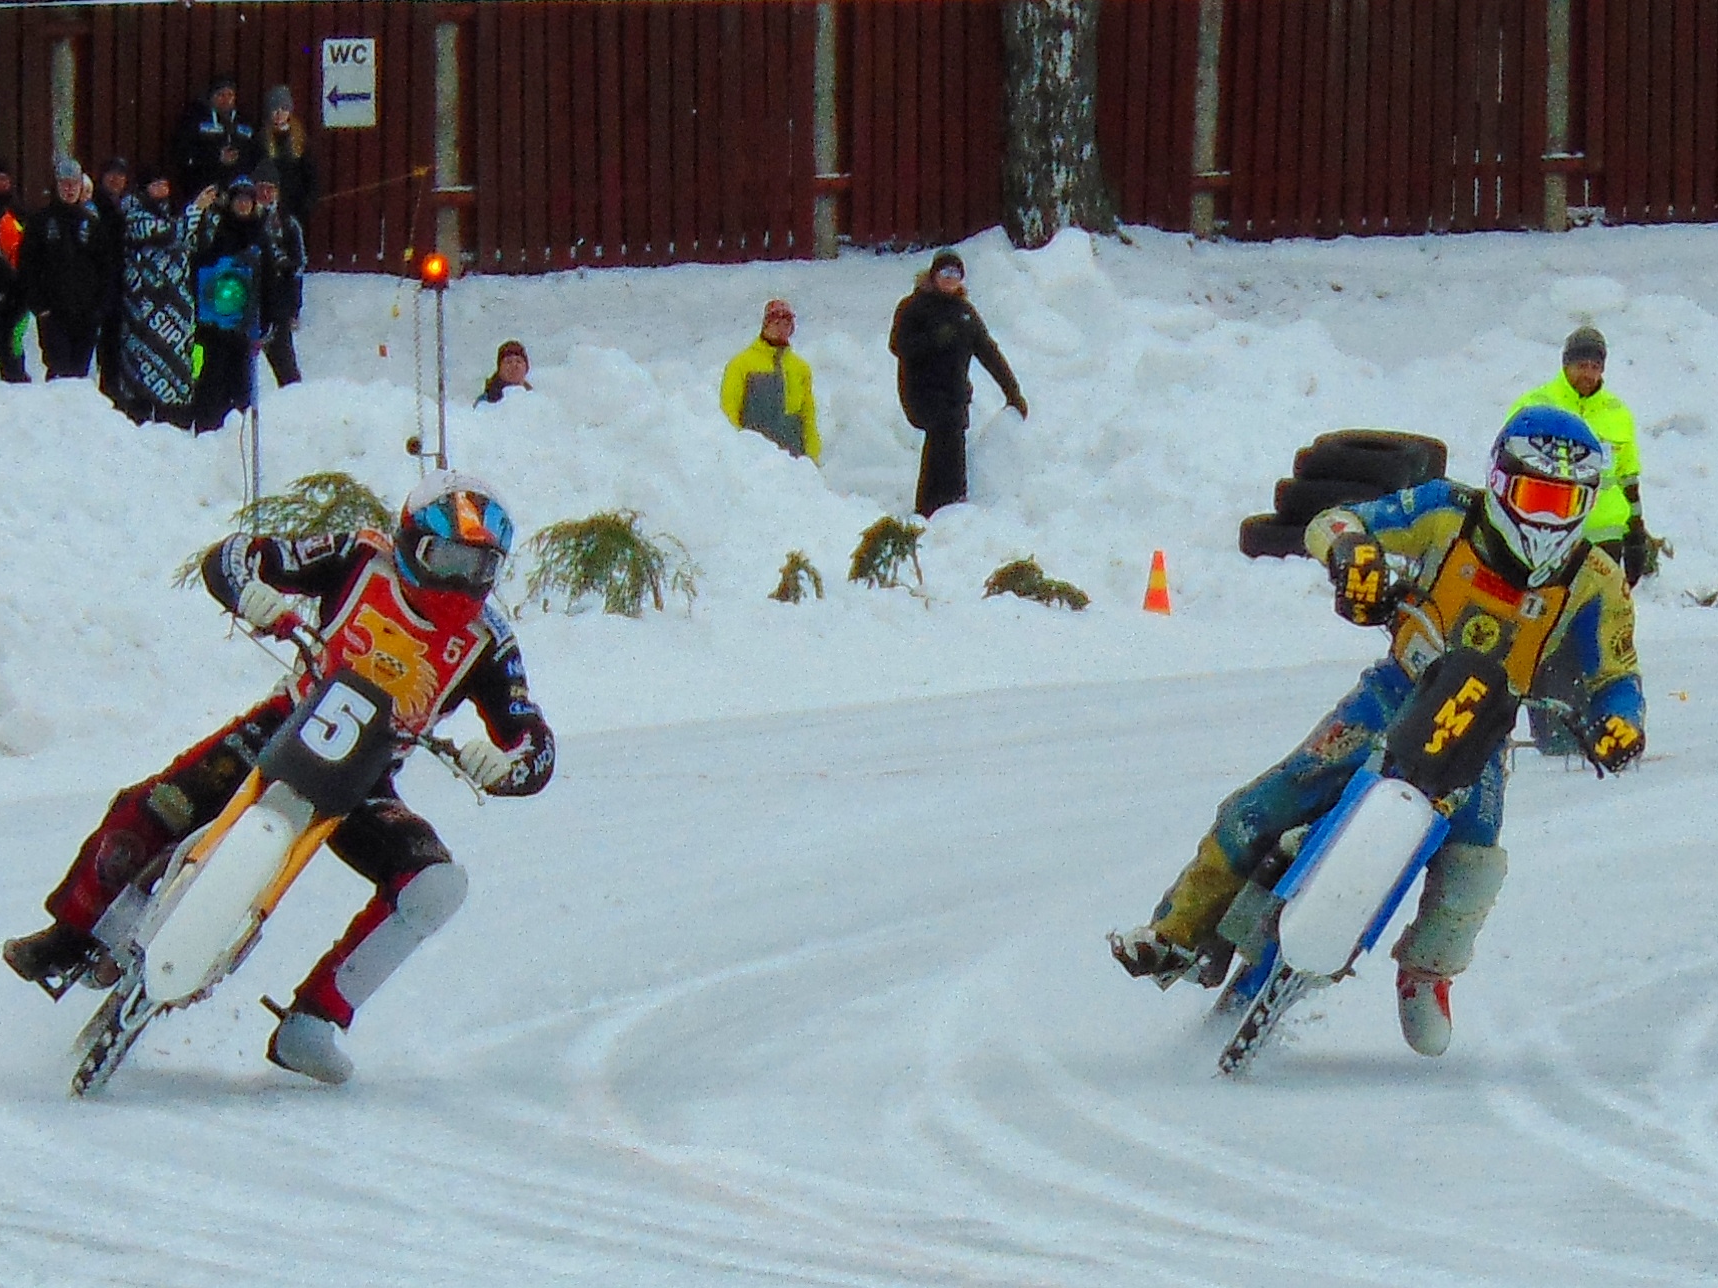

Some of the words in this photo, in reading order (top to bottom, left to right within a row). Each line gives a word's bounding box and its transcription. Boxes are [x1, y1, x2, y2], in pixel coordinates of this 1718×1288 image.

[329, 44, 367, 64] WC
[443, 636, 466, 663] 5
[299, 681, 377, 762] 5
[1424, 676, 1488, 754] FMS
